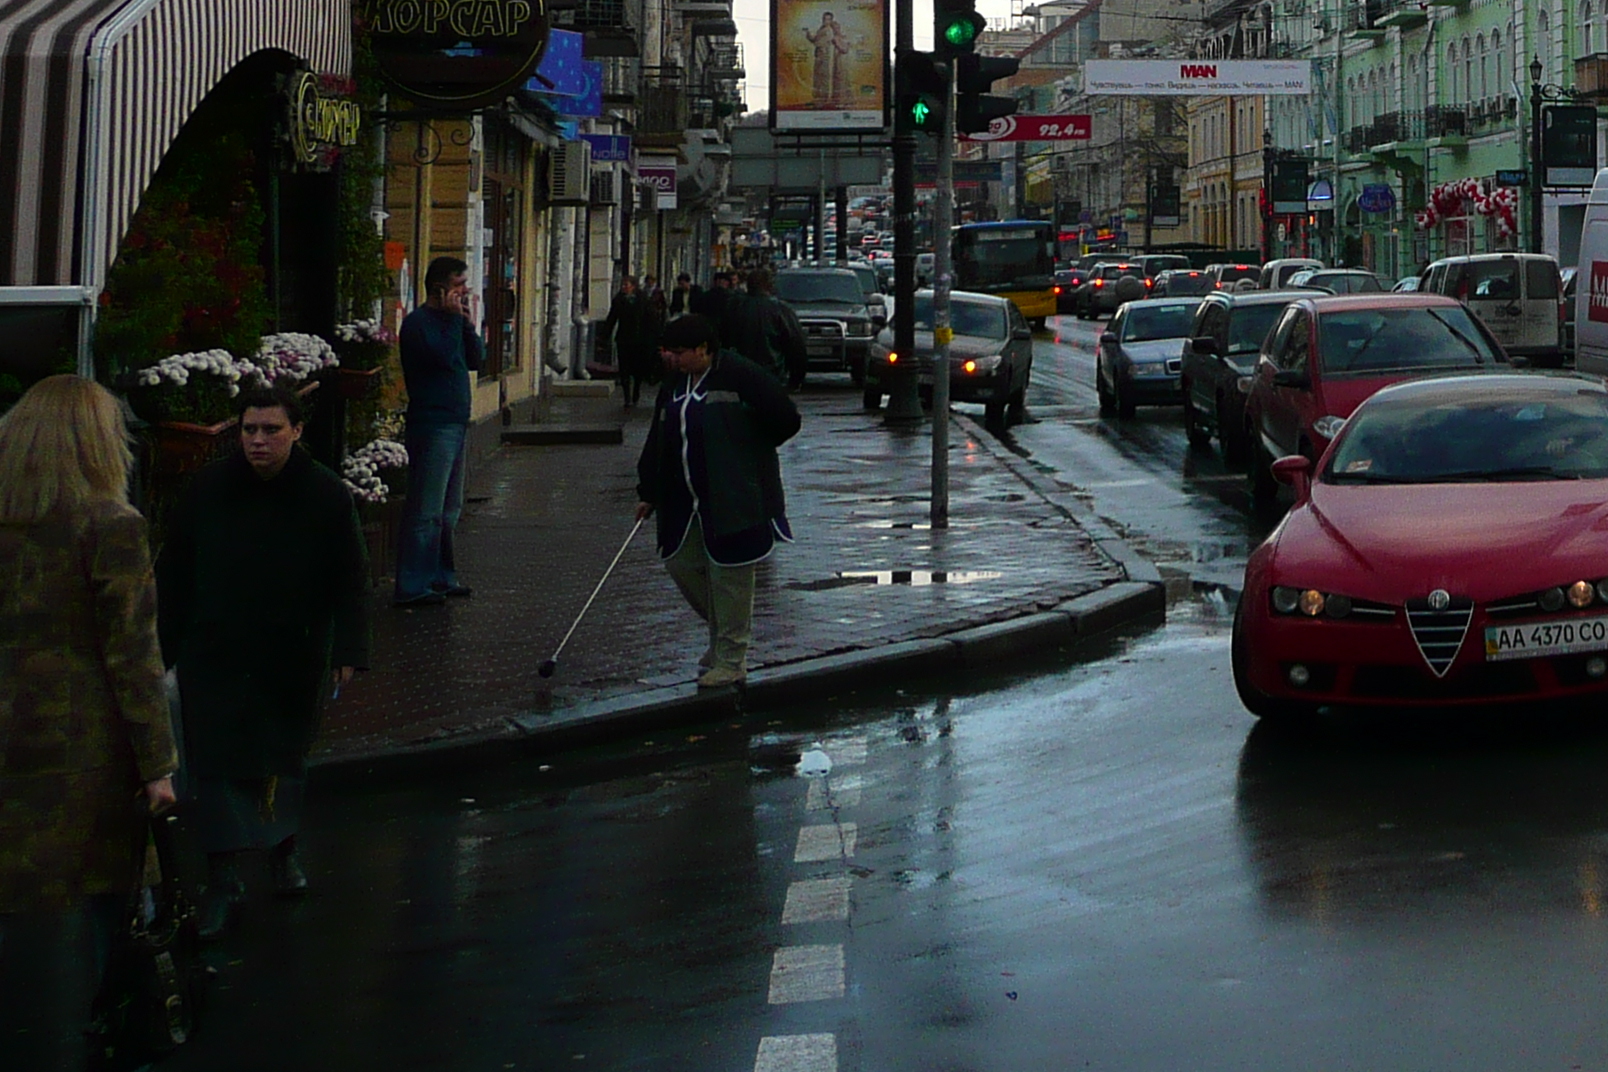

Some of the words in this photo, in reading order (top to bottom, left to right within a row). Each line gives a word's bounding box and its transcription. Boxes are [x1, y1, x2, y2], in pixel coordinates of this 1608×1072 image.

[1180, 64, 1217, 79] MAN
[1039, 123, 1075, 137] 92,4
[1499, 628, 1526, 649] AA
[1531, 623, 1575, 646] 4370
[1579, 621, 1606, 641] CO
